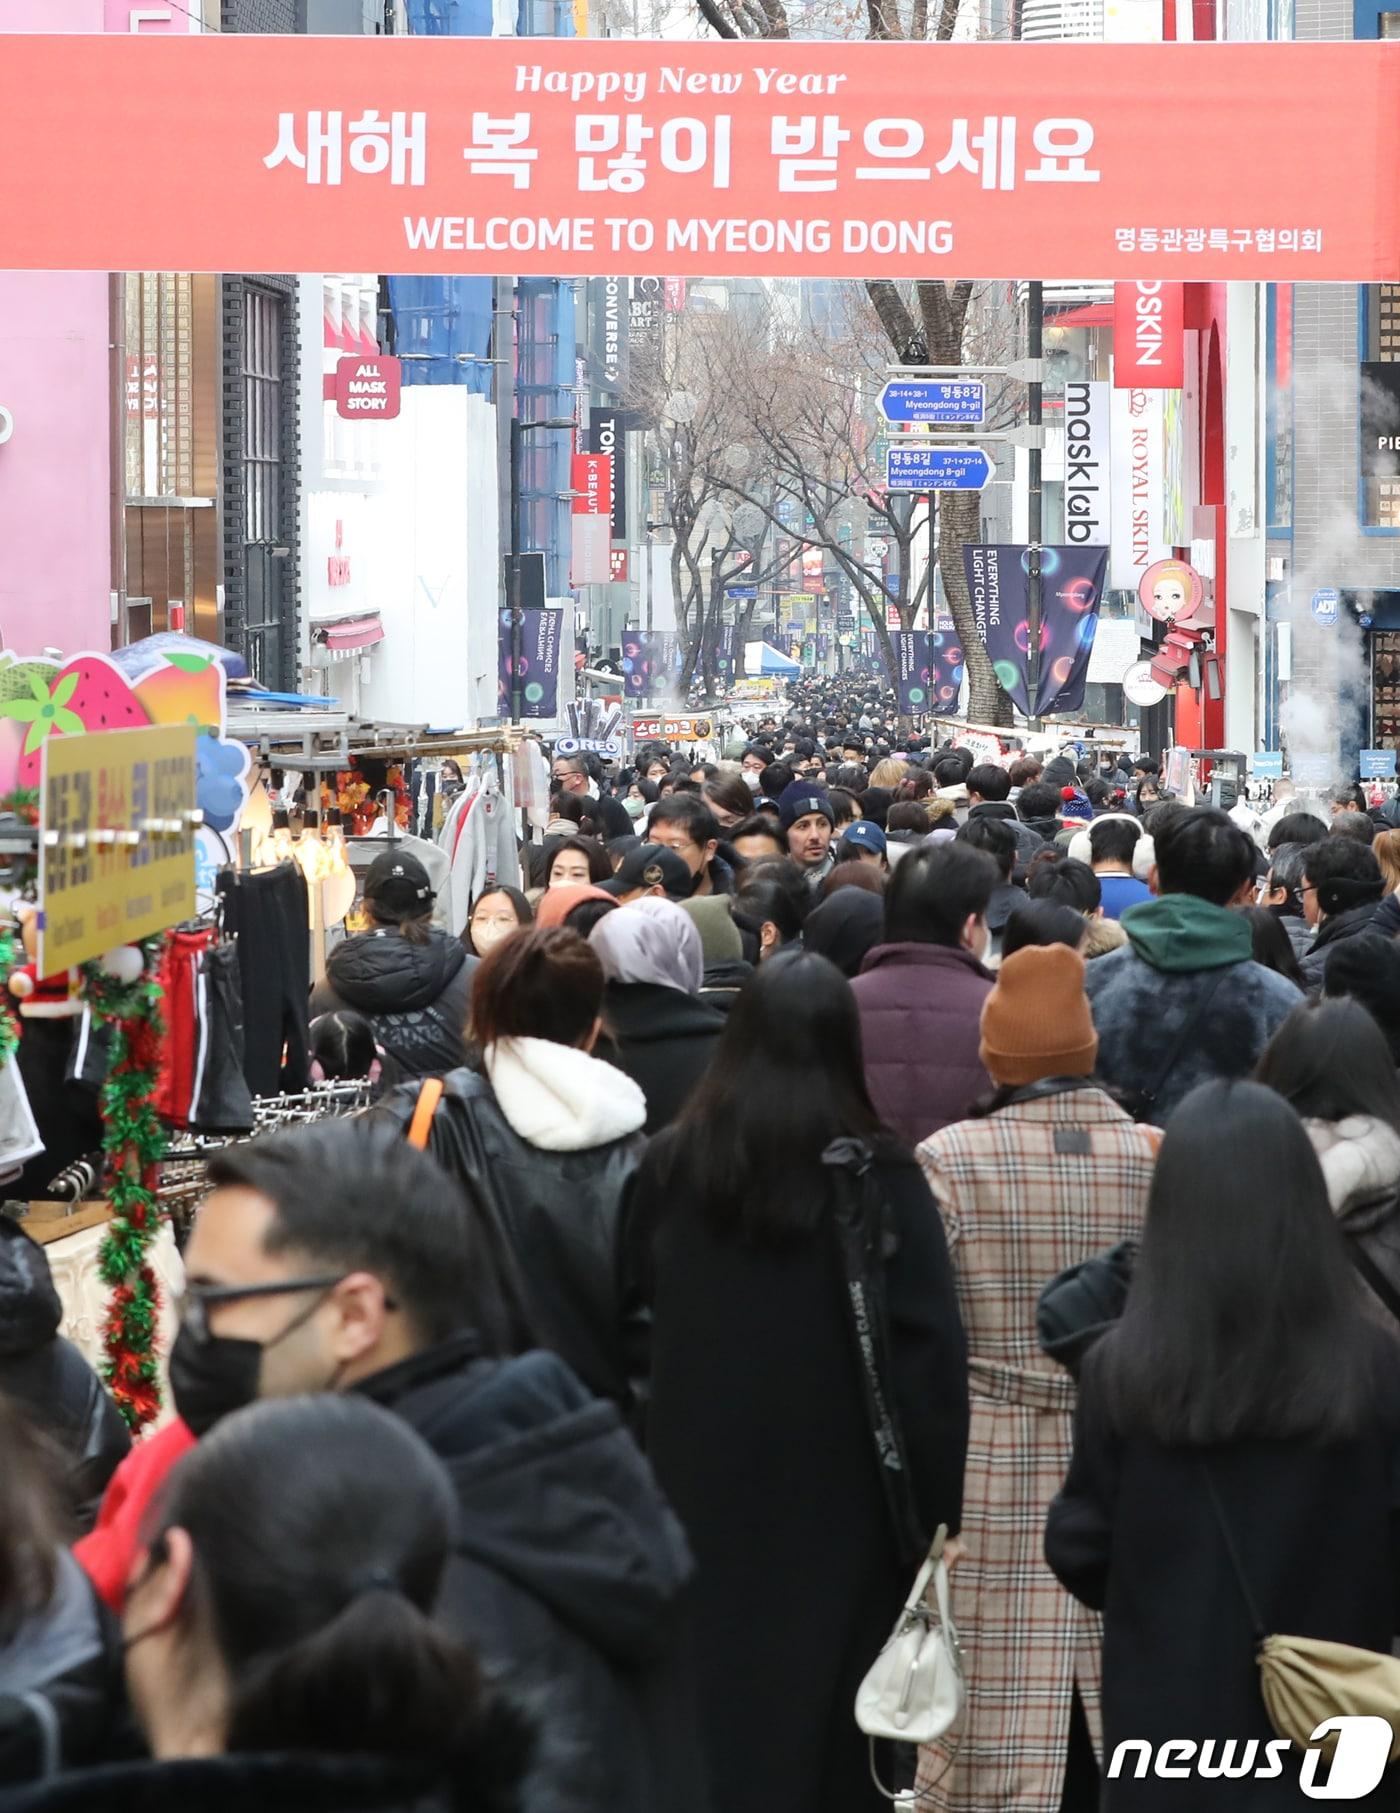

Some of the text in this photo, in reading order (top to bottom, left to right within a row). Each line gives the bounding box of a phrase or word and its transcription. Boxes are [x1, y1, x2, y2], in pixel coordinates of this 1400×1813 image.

[516, 66, 847, 102] Happy New Year
[263, 110, 1101, 193] 새해 복 많이 받으세요
[404, 217, 953, 254] WELCOME TO MYEONG DONG
[1115, 227, 1322, 253] 명동관광특구협의회
[356, 365, 381, 377] ALL
[349, 381, 387, 394] MASK
[941, 386, 981, 399] 명동8길
[347, 398, 387, 410] STORY
[905, 401, 981, 411] Myeongdong 8-gil
[891, 453, 931, 465] 명동8길
[891, 468, 965, 477] Myeongdong 8-gil
[1132, 428, 1149, 567] ROYAL SKIN
[973, 550, 984, 585] LIGHT
[987, 550, 1000, 625] EVERYTHING
[560, 738, 618, 753] OREO
